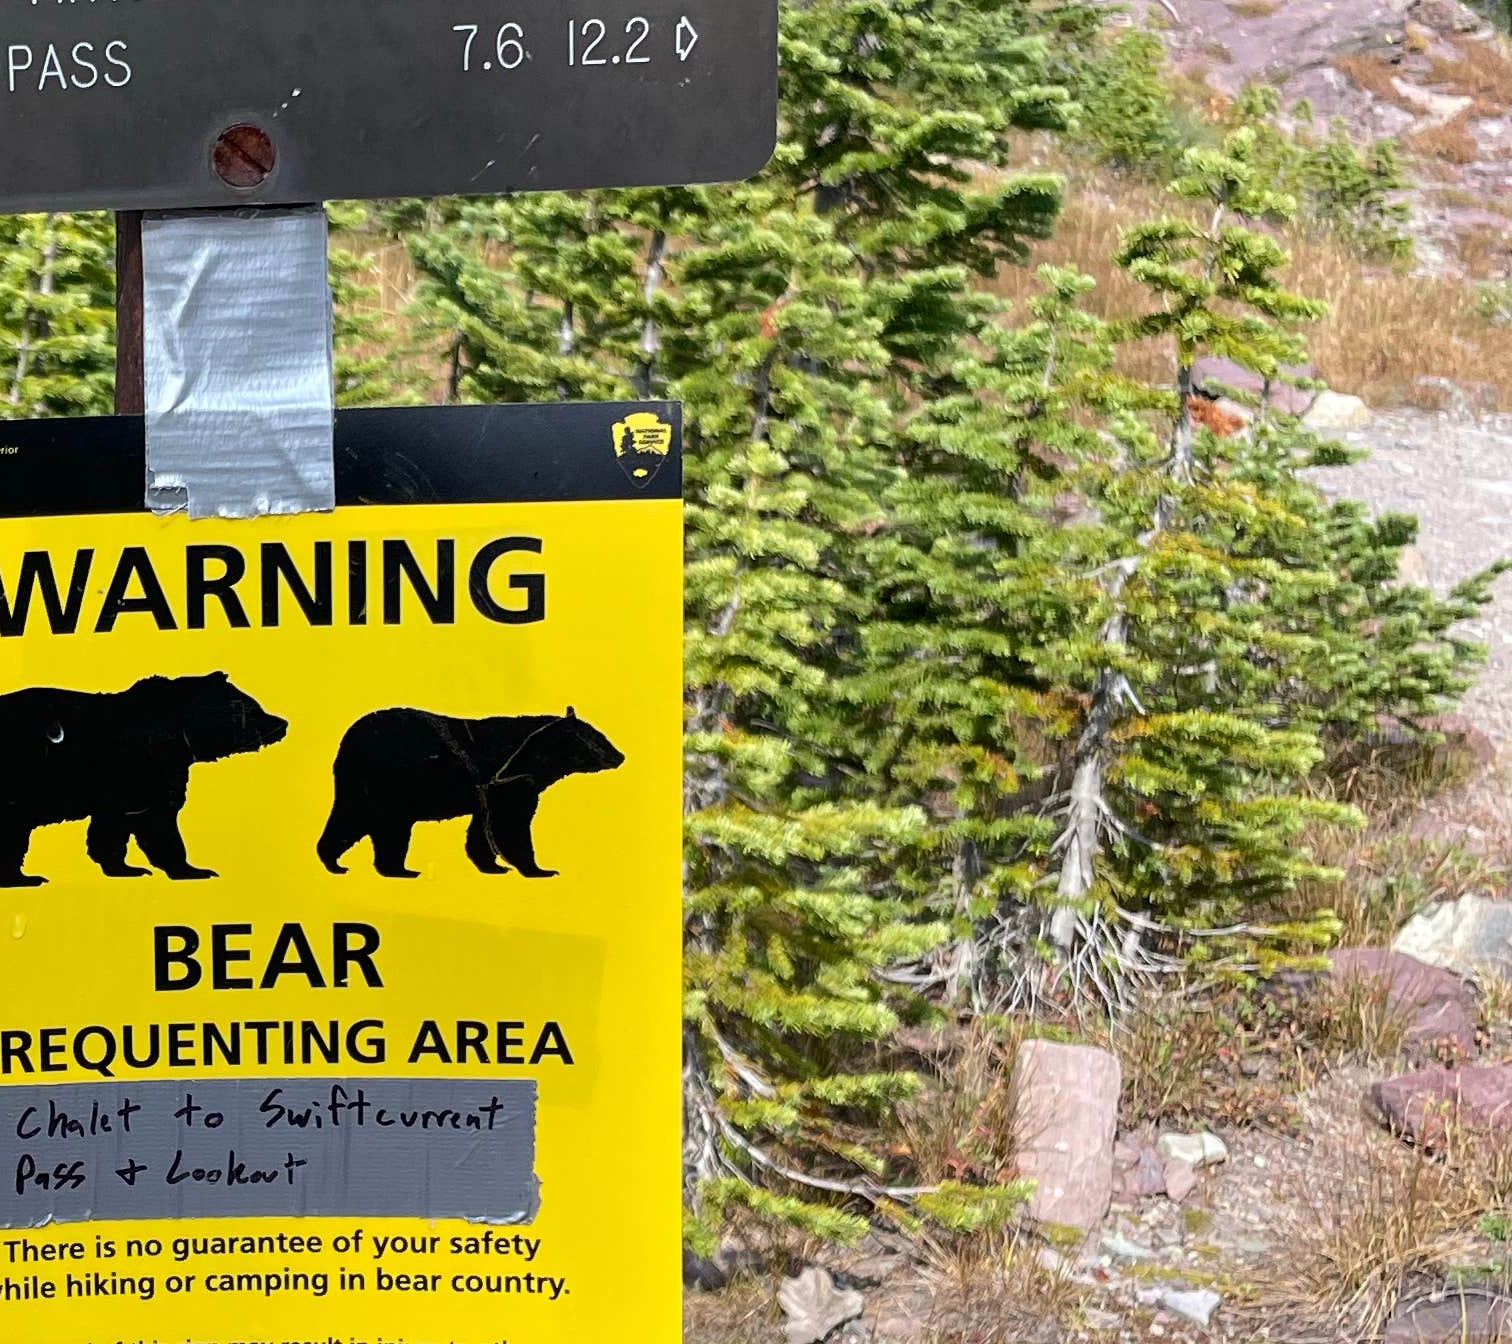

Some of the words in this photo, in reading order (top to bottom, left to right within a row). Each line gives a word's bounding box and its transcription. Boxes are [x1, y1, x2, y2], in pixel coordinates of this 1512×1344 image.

[8, 40, 131, 92] PASS
[452, 22, 524, 71] 7.6
[569, 16, 651, 66] 12.2
[153, 922, 384, 992] BEAR
[407, 1019, 575, 1066] AREA
[16, 1097, 142, 1140] Chalet
[173, 1093, 225, 1130] to
[258, 1083, 505, 1131] Swiftcurrent
[15, 1153, 87, 1196] Pass
[165, 1149, 309, 1187] Lookout
[3, 1238, 85, 1263] There
[95, 1235, 116, 1259] is
[126, 1239, 163, 1257] no
[172, 1232, 323, 1262] guarantee
[332, 1229, 364, 1253] of
[372, 1233, 441, 1260] your
[449, 1230, 541, 1262] safety
[66, 1270, 155, 1301] hiking
[165, 1275, 196, 1293] or
[205, 1267, 327, 1297] camping
[340, 1267, 366, 1291] in
[376, 1266, 442, 1292] bear
[451, 1271, 570, 1301] country.
